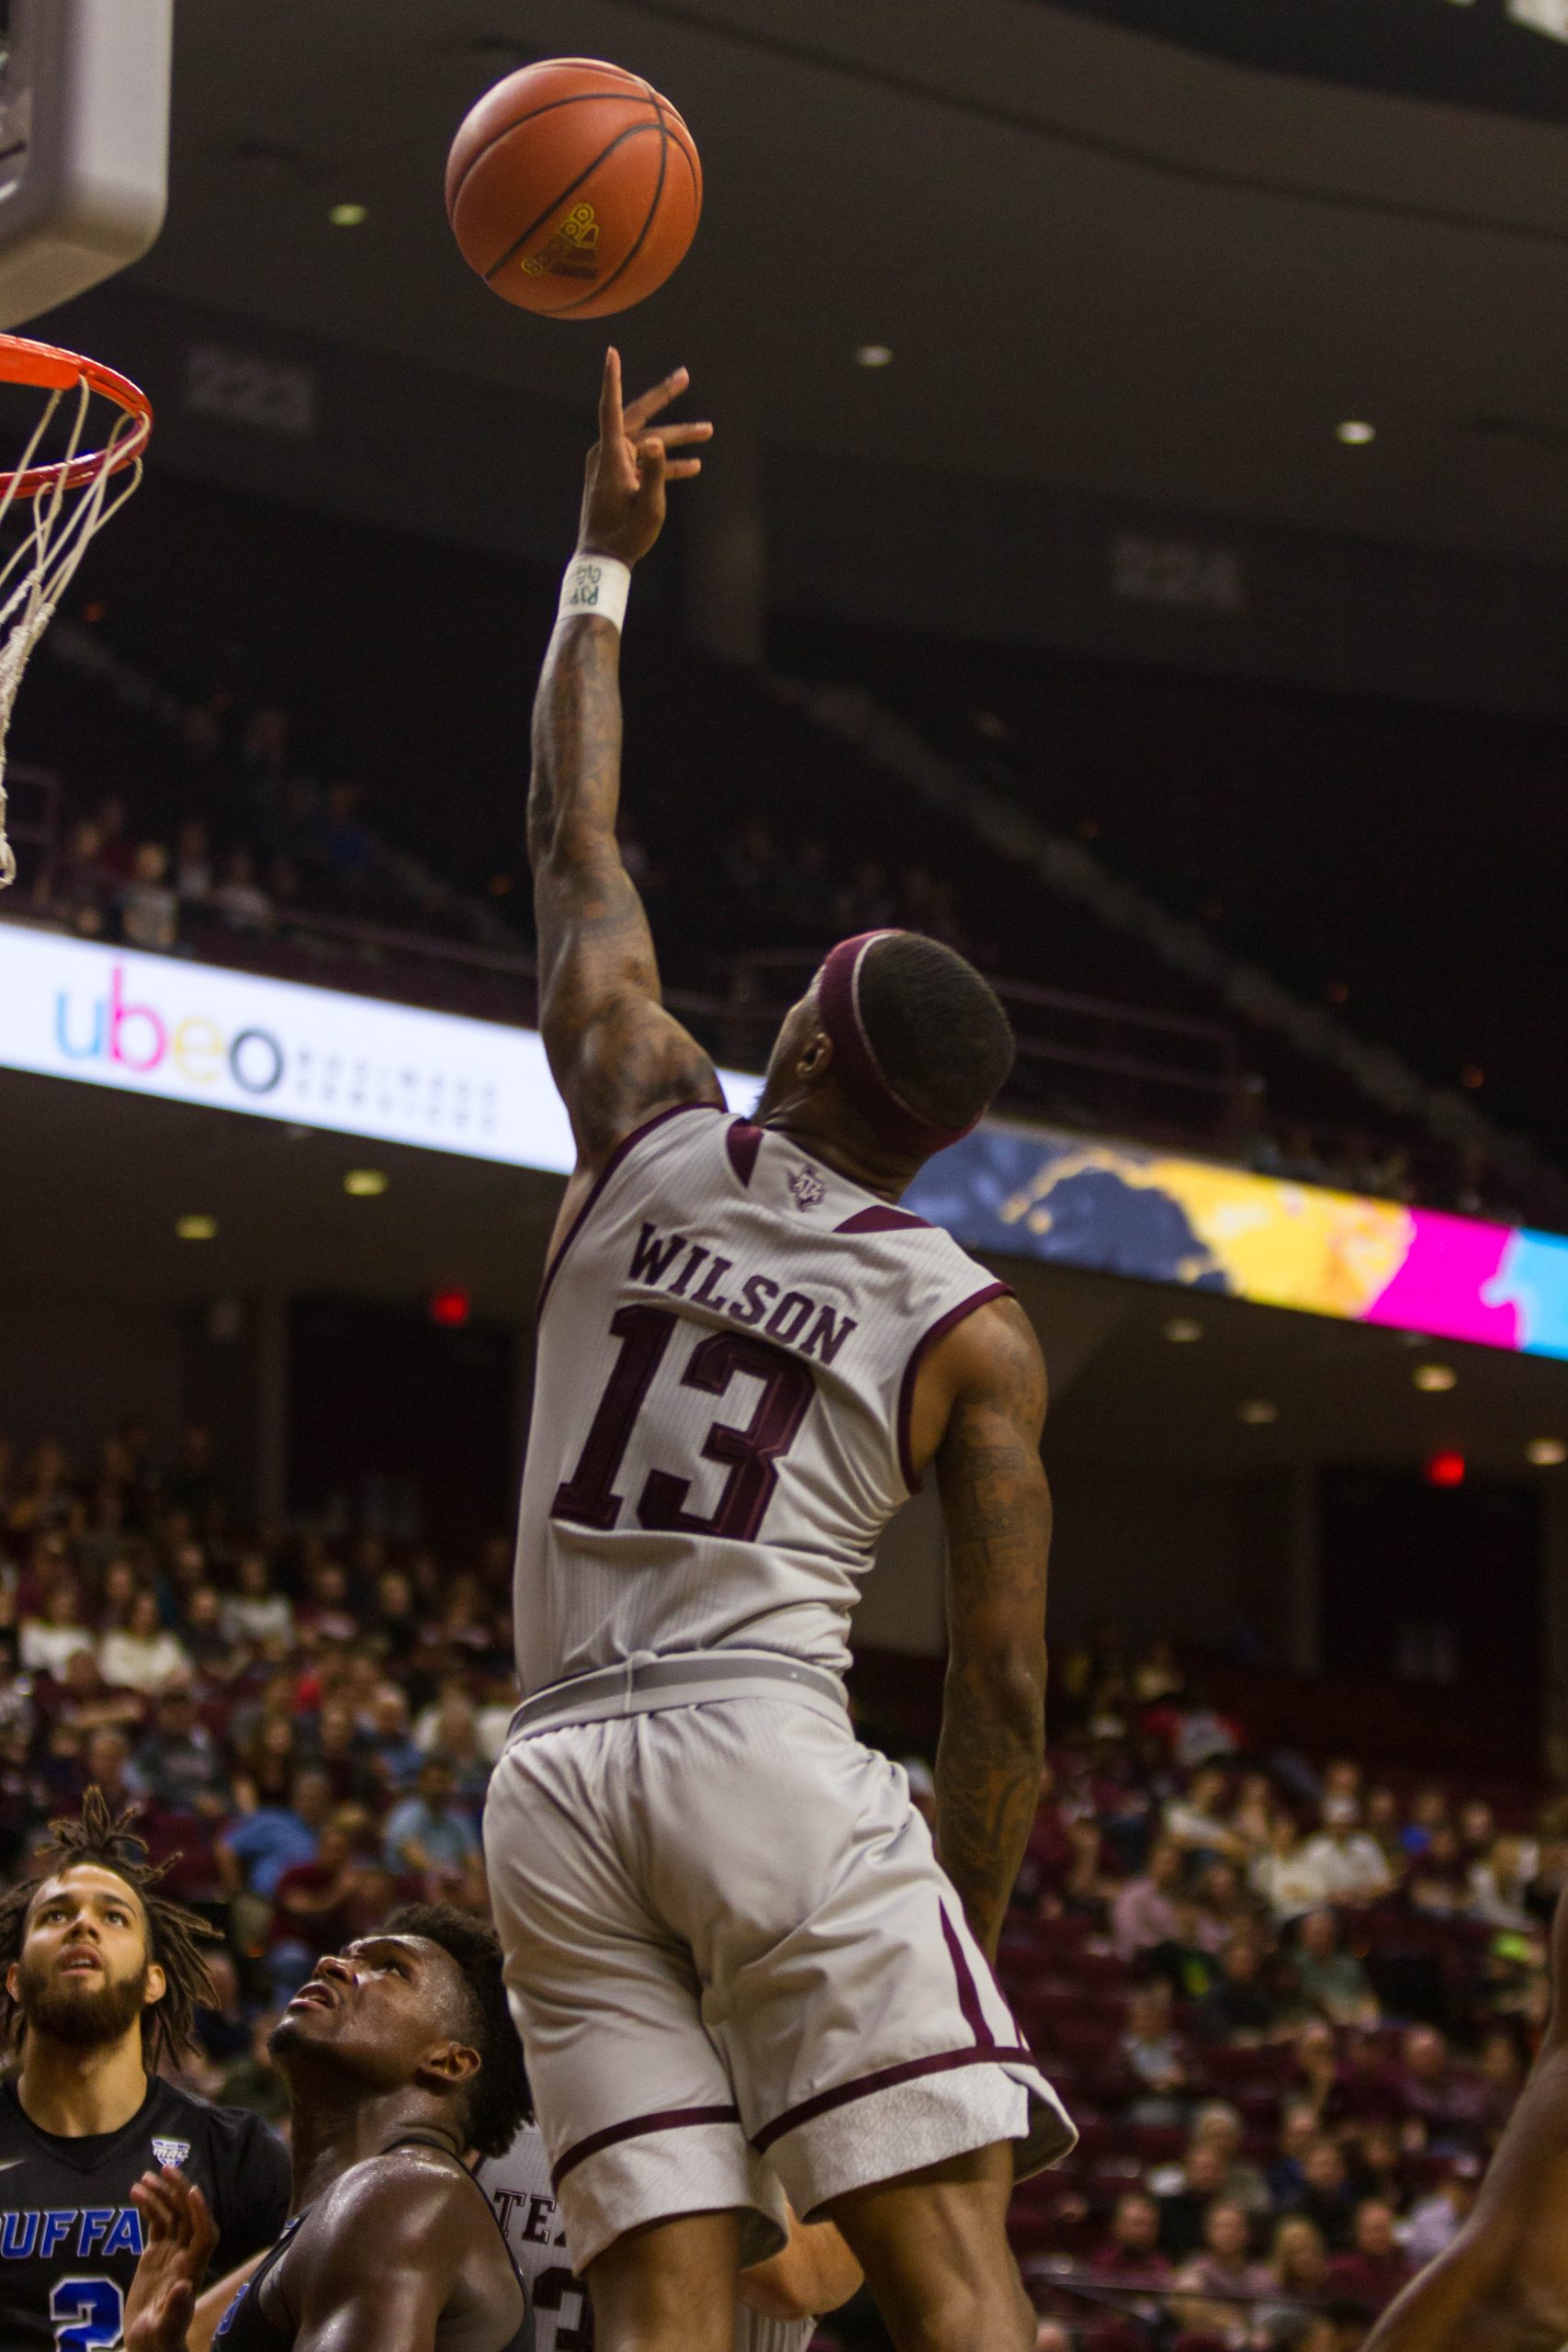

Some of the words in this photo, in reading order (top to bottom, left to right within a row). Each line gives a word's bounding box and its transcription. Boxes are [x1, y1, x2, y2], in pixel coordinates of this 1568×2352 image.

[55, 963, 285, 1095] ubeo
[627, 1221, 858, 1366] WILSON
[549, 1303, 817, 1544] 13
[0, 2207, 144, 2259] UFFA
[492, 2188, 567, 2248] TE
[49, 2277, 125, 2352] 2
